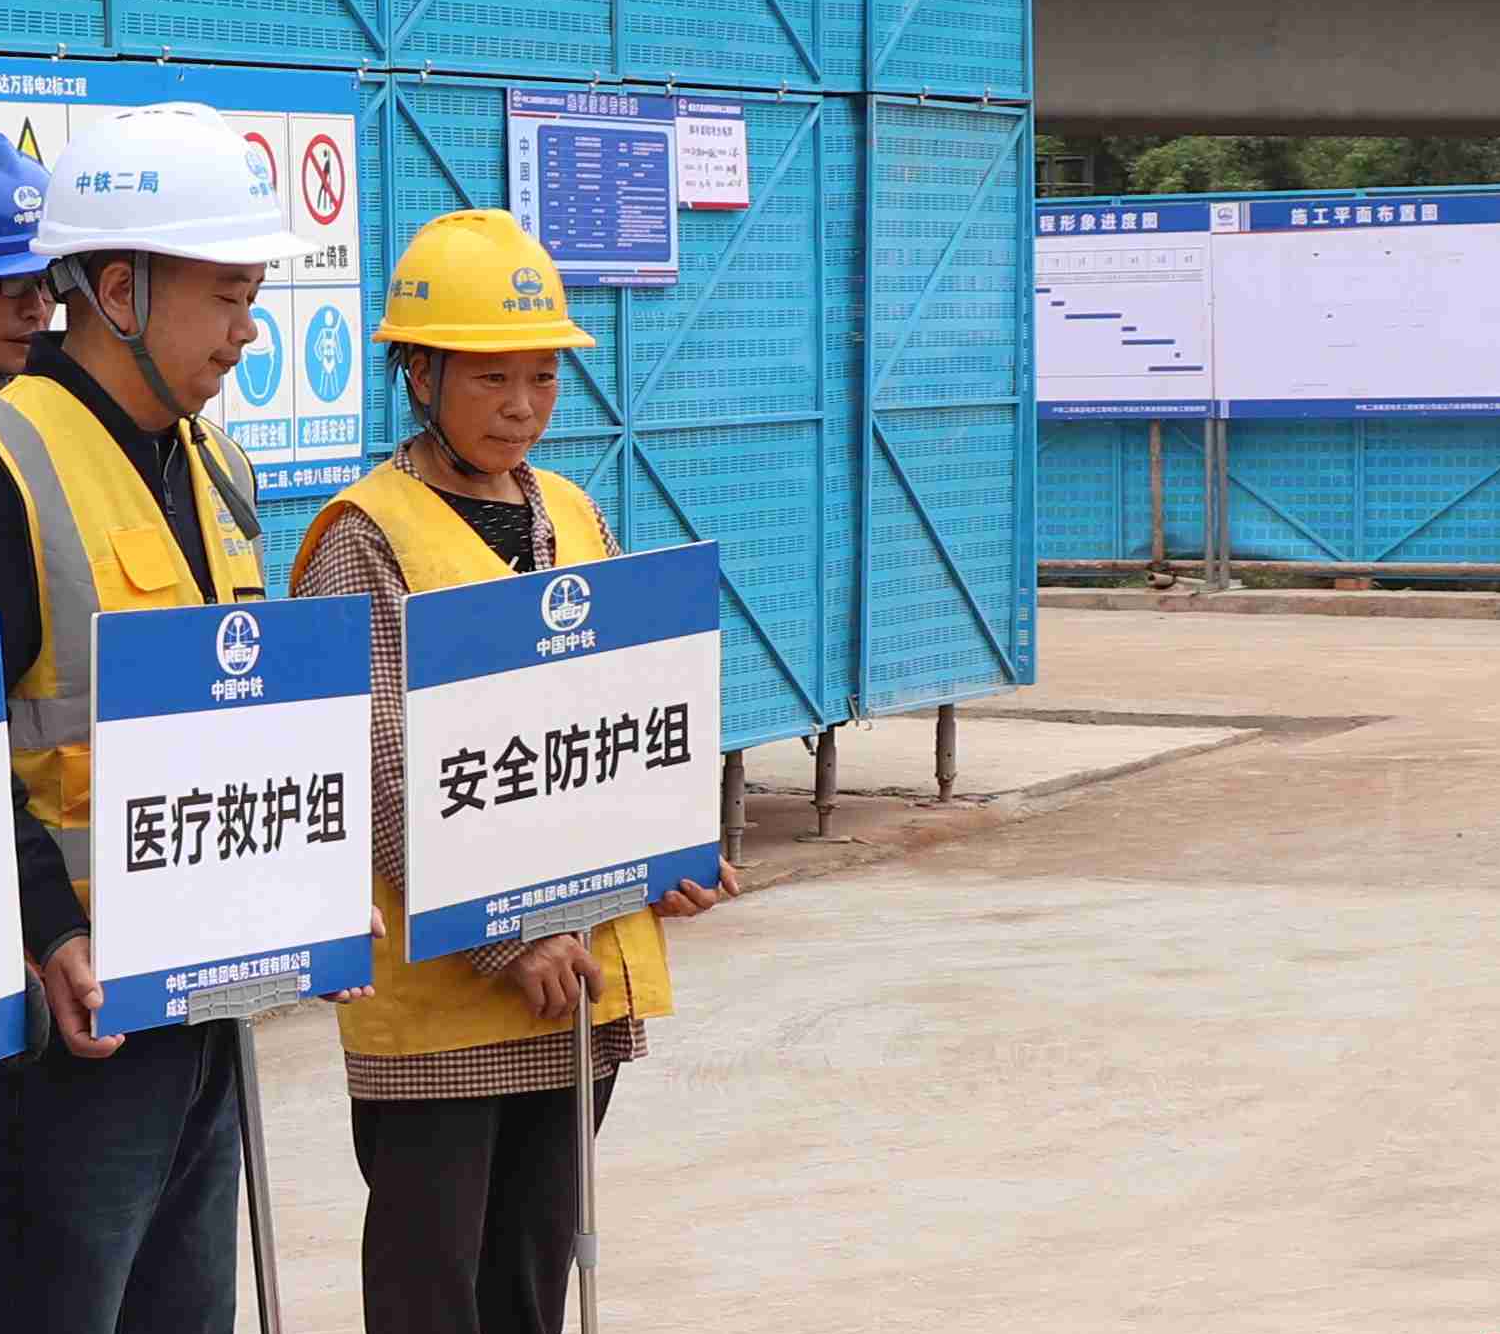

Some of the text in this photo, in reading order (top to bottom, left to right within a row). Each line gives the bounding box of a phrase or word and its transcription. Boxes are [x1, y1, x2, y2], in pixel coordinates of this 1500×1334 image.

[75, 170, 159, 194] 中铁二局
[1291, 203, 1439, 226] 施工平面布置图
[536, 629, 597, 657] 中国中铁
[211, 675, 264, 702] 中国中铁
[439, 702, 691, 820] 安全防护组
[126, 772, 346, 873] 医疗救护组
[485, 863, 649, 917] 中铁二局集团电务工程有限公司
[165, 950, 311, 993] 中铁二局集团电务工程有限公司
